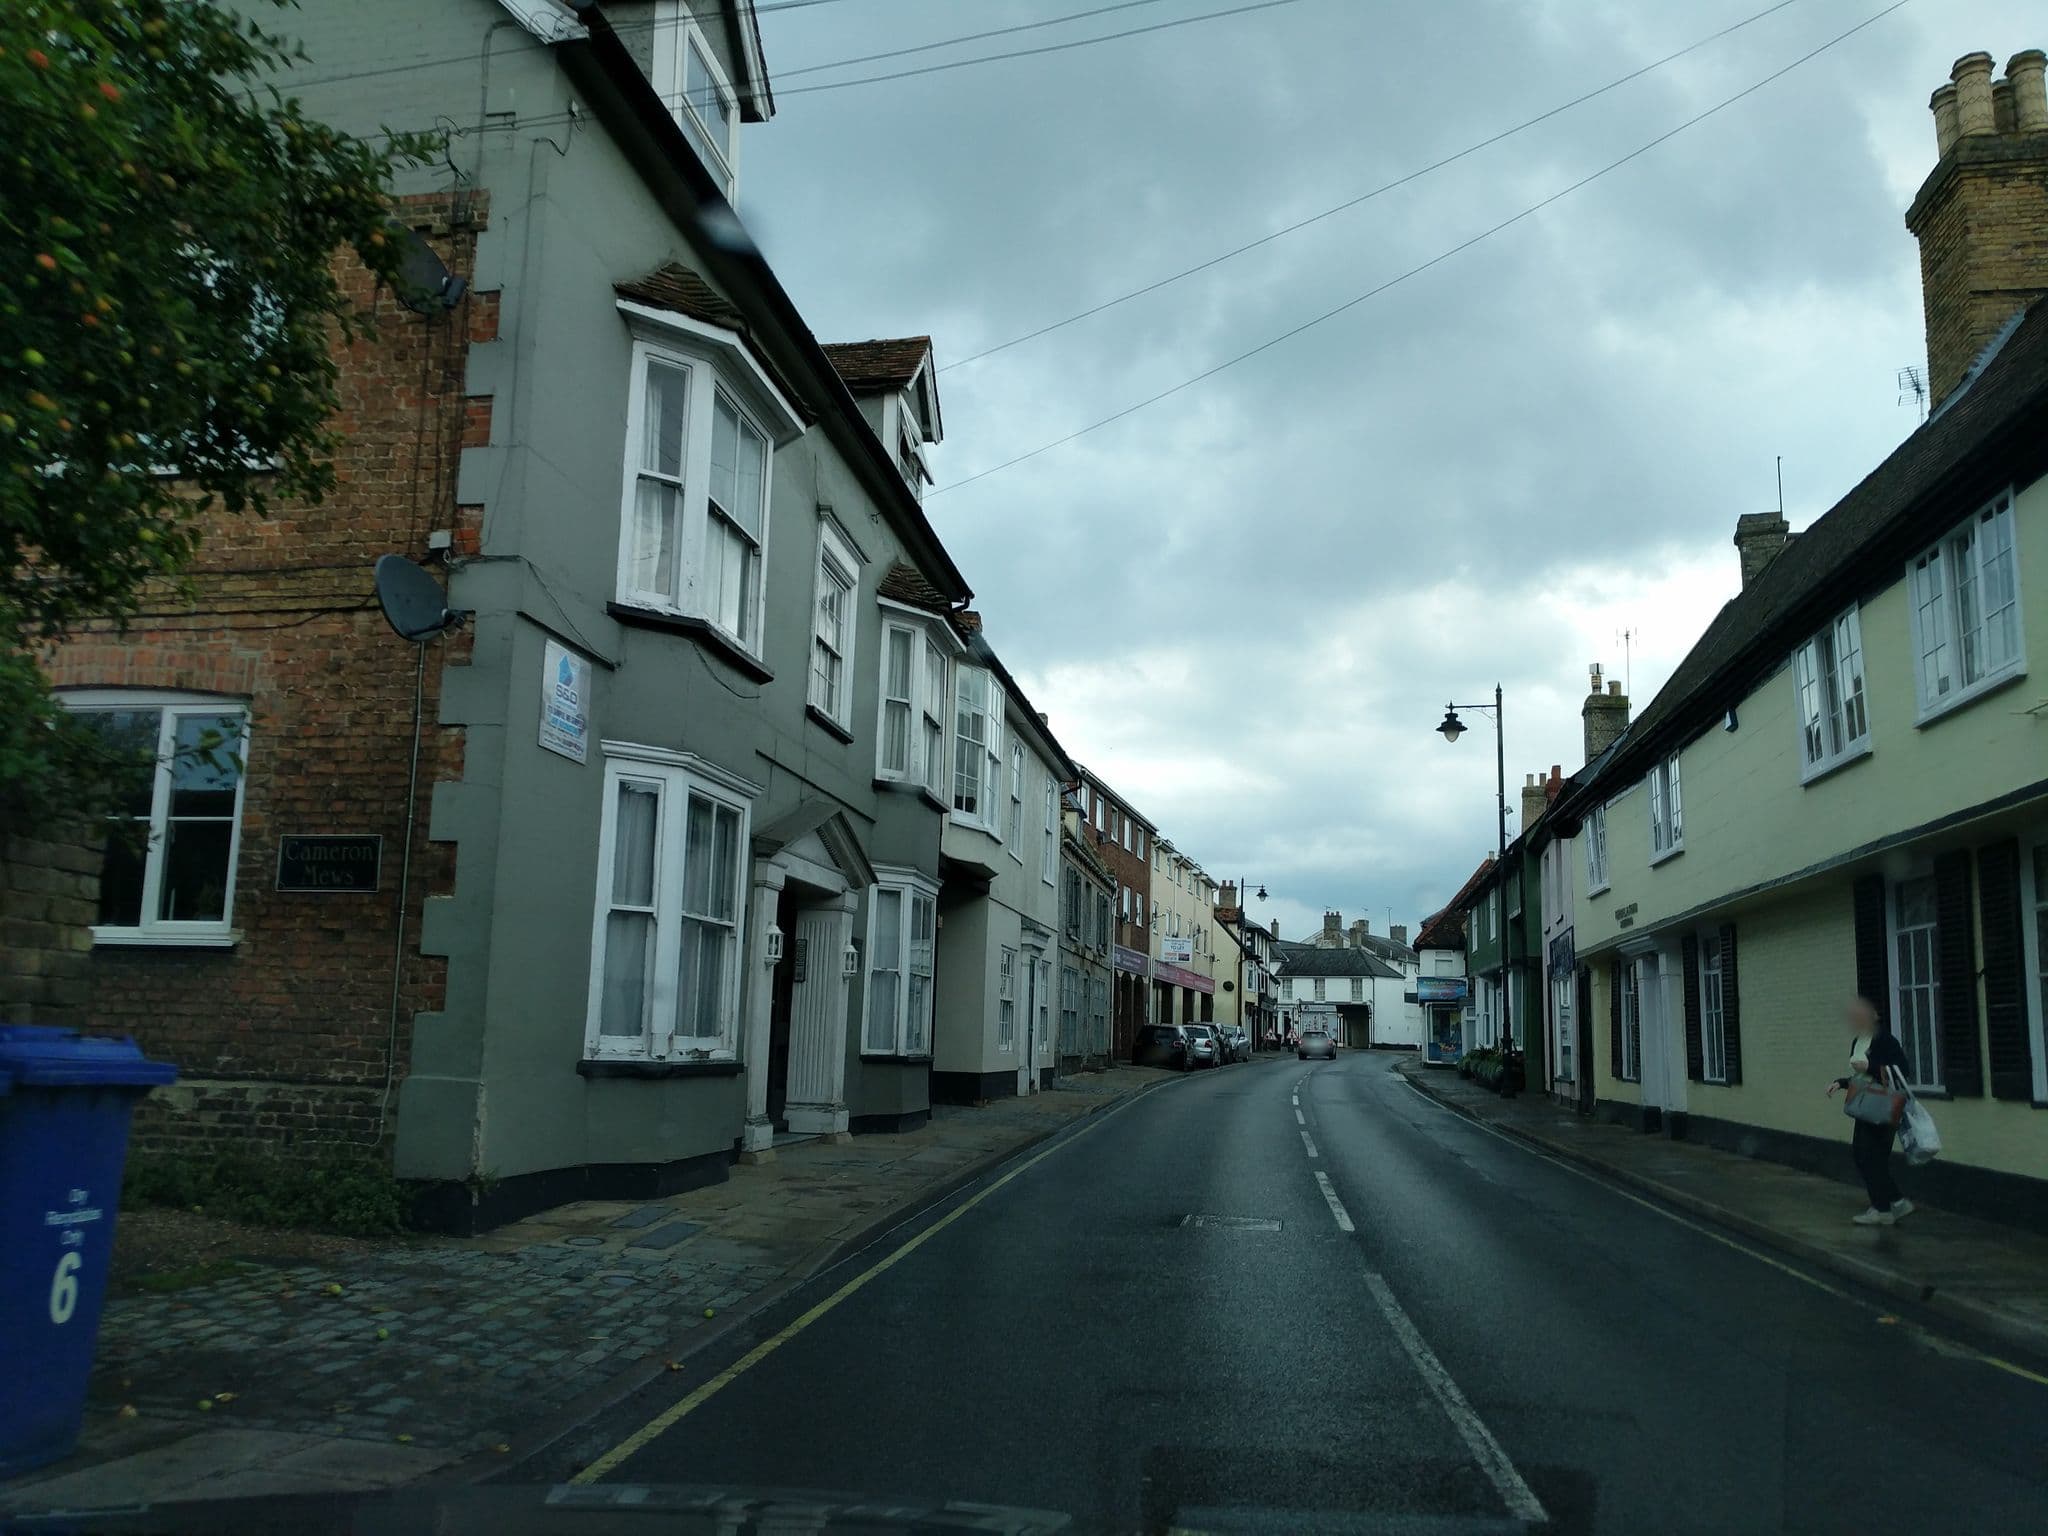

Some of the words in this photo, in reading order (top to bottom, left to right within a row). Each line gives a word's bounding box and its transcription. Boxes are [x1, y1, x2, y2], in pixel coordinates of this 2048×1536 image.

[286, 841, 373, 861] Cameron
[302, 864, 355, 886] Mews
[50, 1251, 82, 1325] 6
